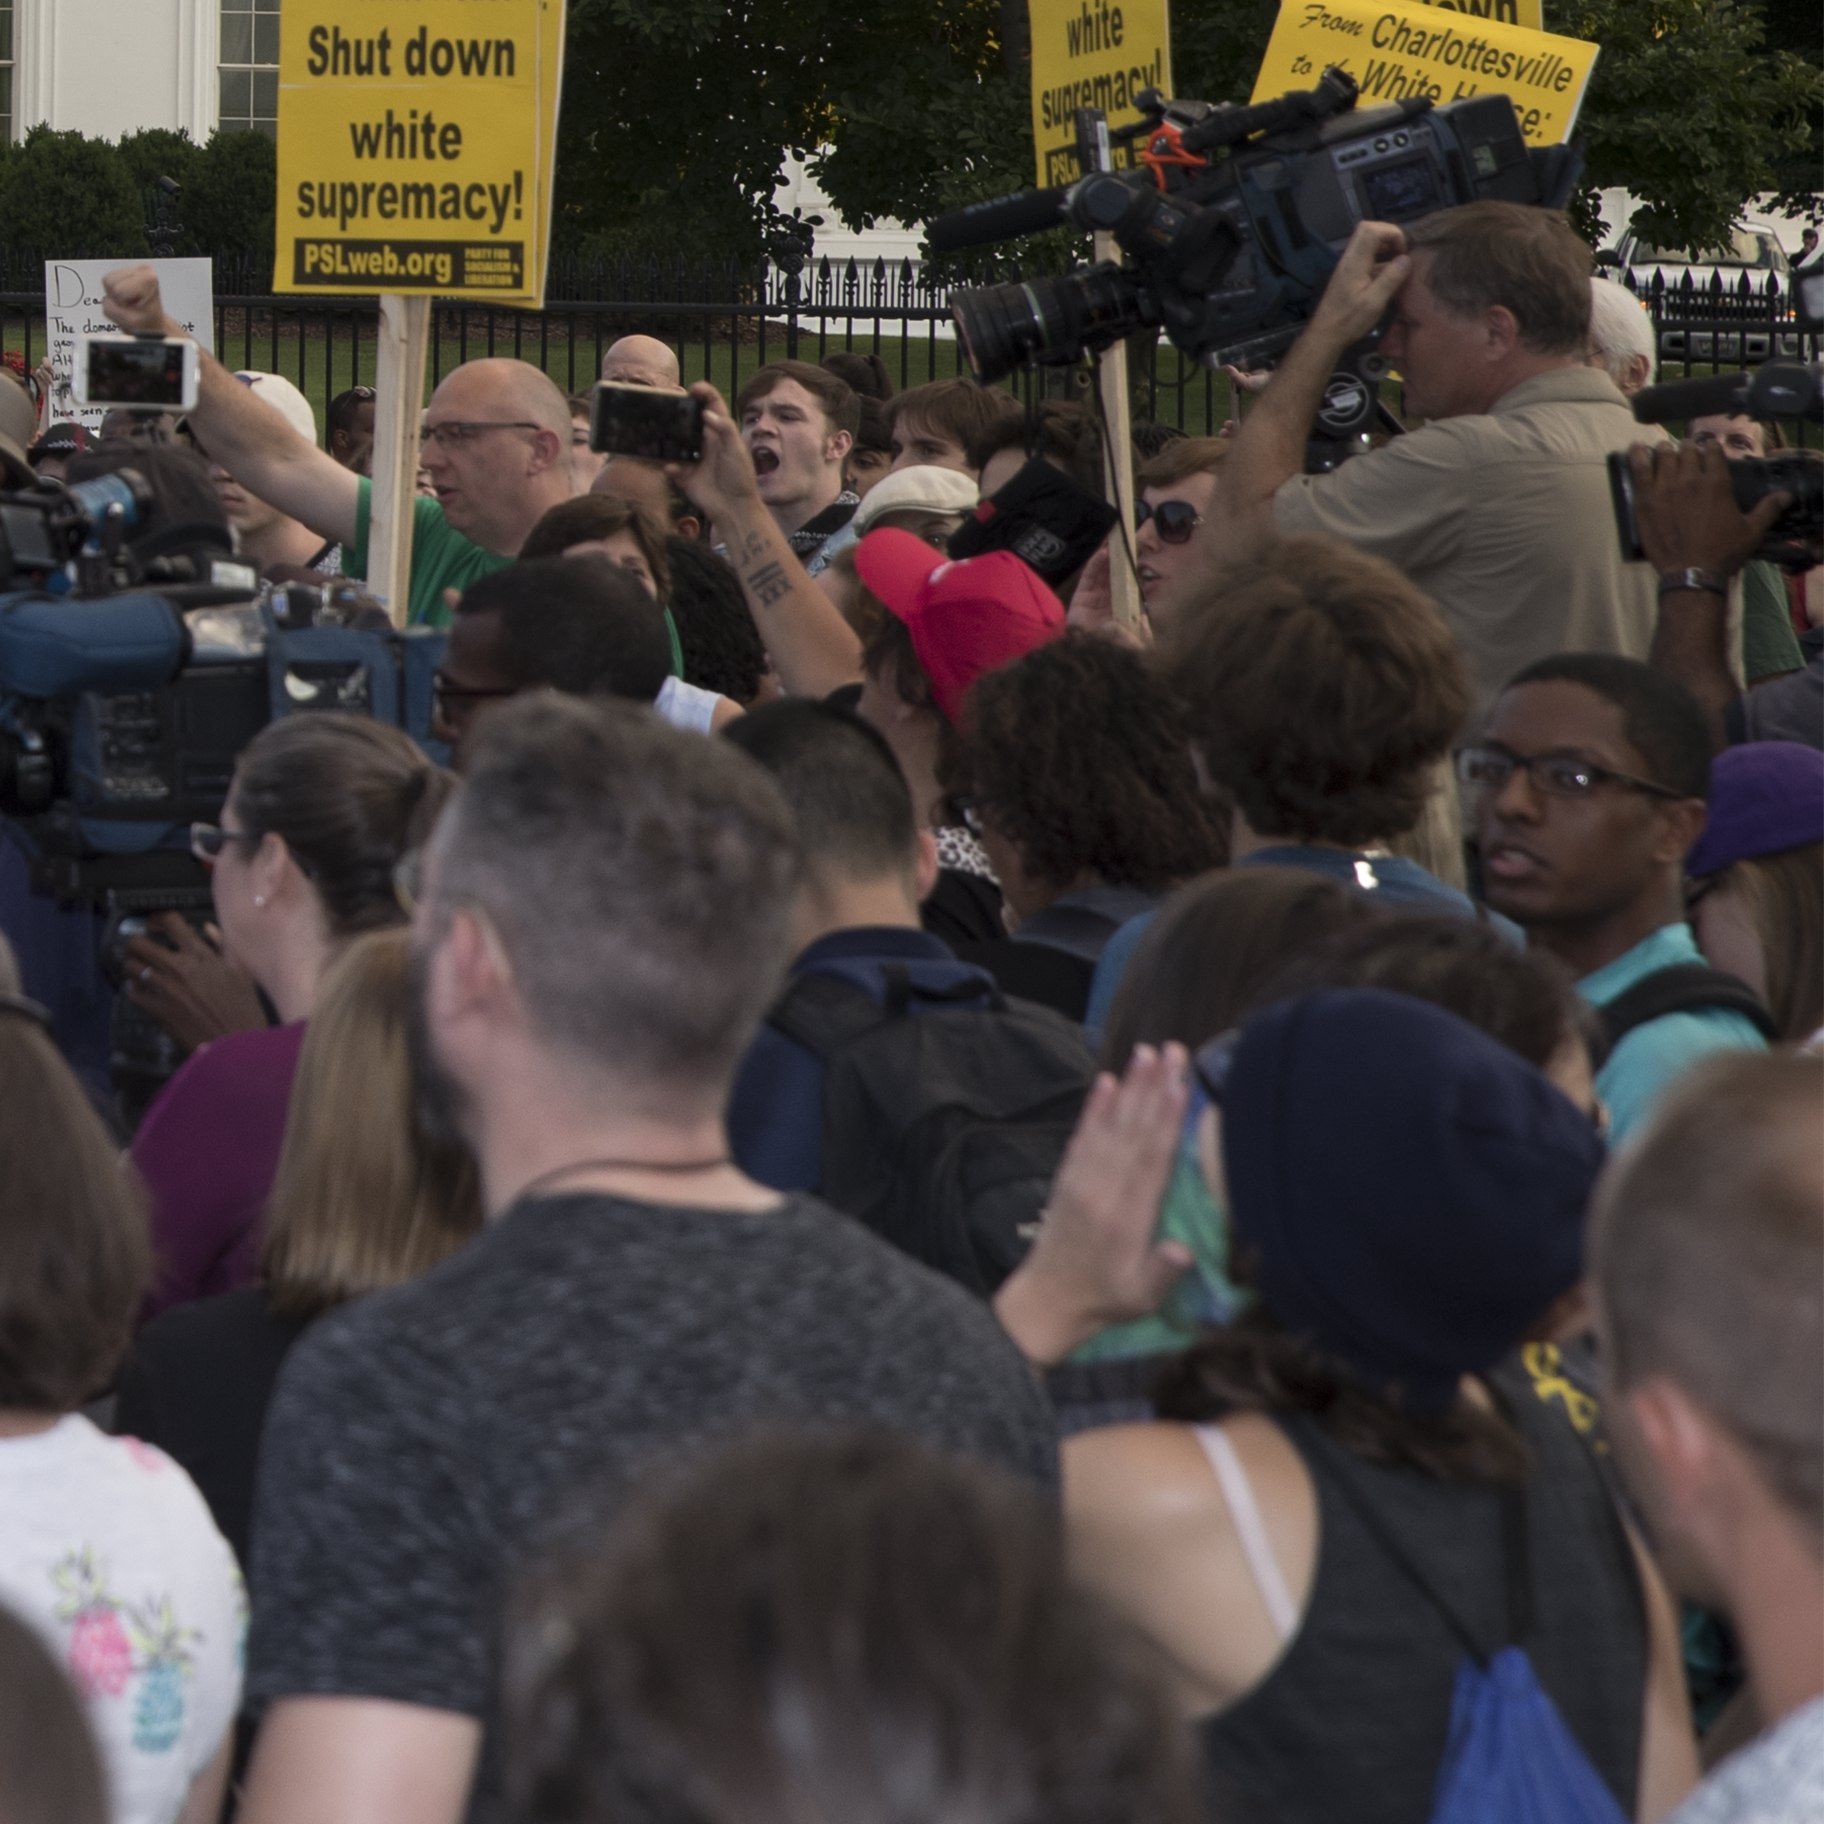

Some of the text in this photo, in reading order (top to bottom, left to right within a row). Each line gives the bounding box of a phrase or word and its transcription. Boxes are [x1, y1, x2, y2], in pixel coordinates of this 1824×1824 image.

[306, 25, 517, 78] Shut down
[1290, 54, 1313, 76] to
[1298, 3, 1574, 94] From Charlottesville
[1041, 47, 1163, 138] supremacy!
[349, 108, 463, 161] white
[297, 170, 524, 235] supremacy!
[52, 265, 103, 309] Dea
[303, 243, 453, 285] PSLweb.org
[49, 316, 75, 334] The
